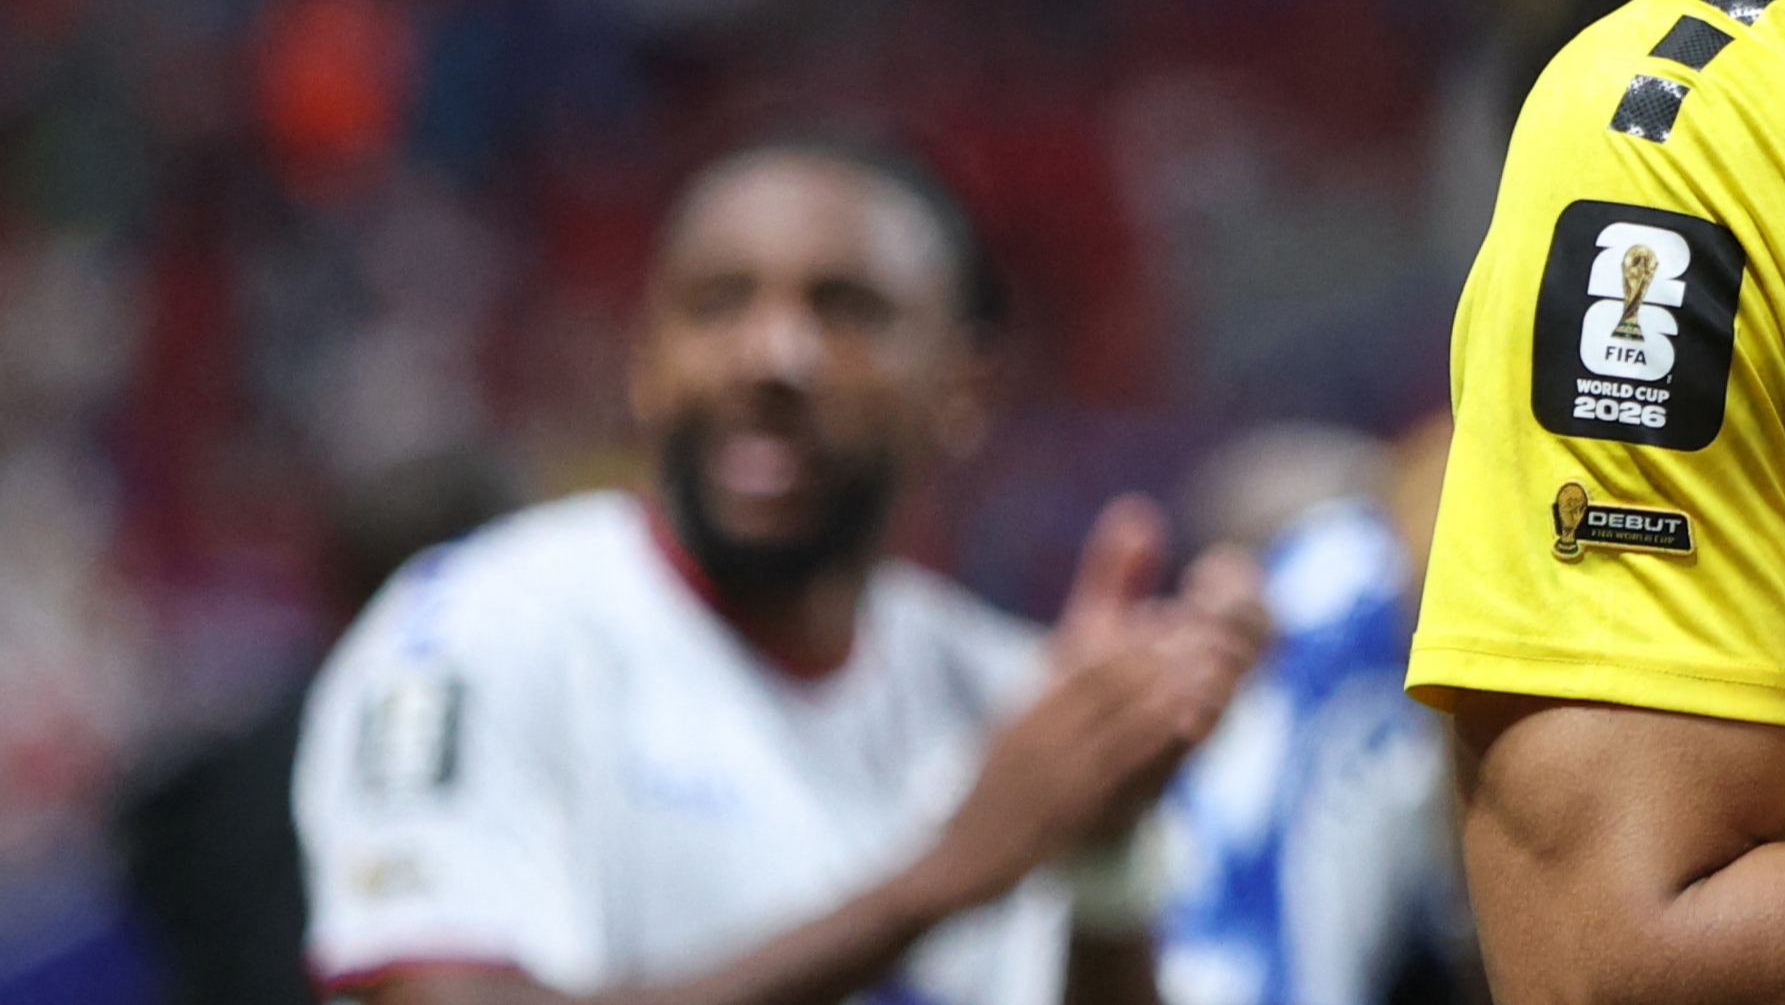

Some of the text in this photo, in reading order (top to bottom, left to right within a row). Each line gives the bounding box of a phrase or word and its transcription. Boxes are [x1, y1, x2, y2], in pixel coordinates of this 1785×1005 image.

[1604, 345, 1647, 365] FIFA
[1576, 378, 1670, 403] WORLD CUP
[1572, 396, 1667, 428] 2026
[1587, 511, 1682, 534] DEBUT
